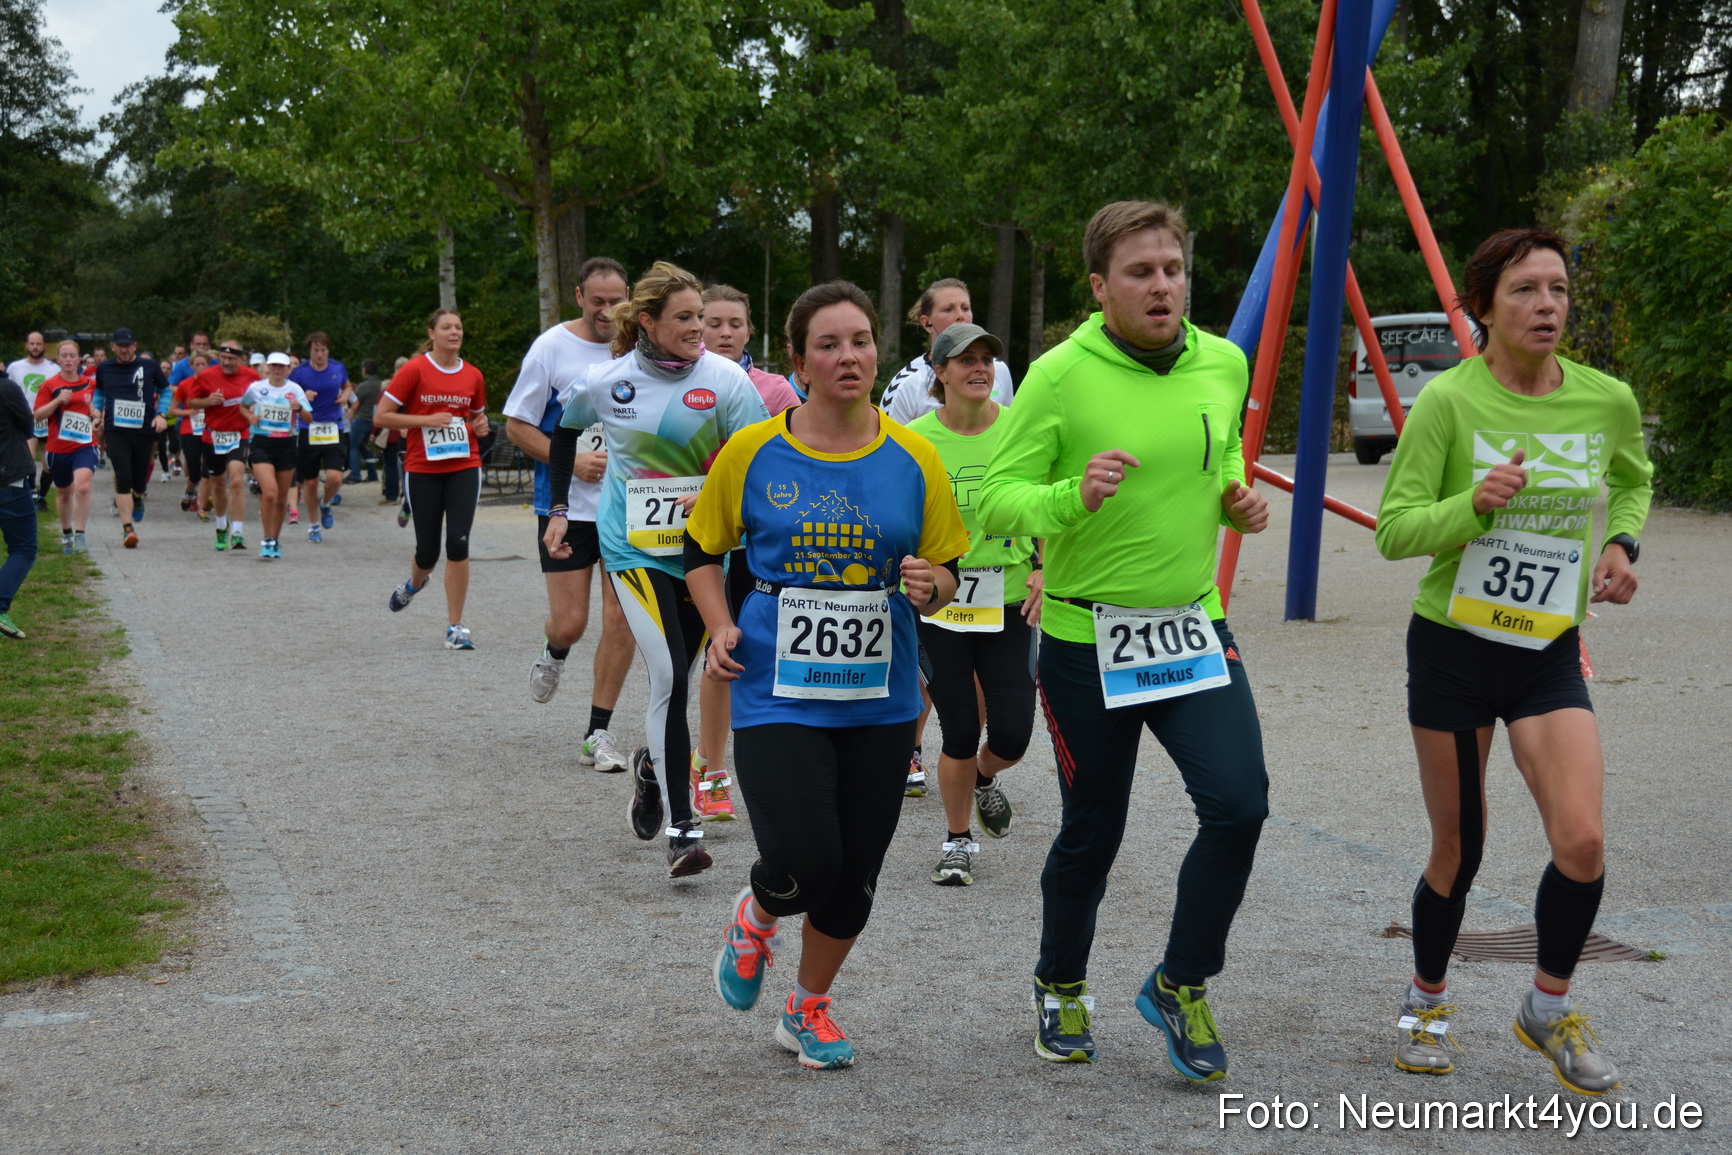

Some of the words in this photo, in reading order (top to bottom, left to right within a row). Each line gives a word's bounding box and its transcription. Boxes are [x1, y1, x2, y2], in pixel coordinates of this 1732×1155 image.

[117, 406, 142, 419] 2060
[264, 408, 290, 422] 2182
[613, 407, 637, 415] PARTL
[64, 418, 91, 434] 2426
[315, 426, 332, 435] 241
[428, 426, 465, 445] 2160
[1589, 432, 1605, 488] 2015
[628, 486, 656, 495] PARTL
[658, 485, 698, 494] Neumarkt
[657, 533, 684, 545] Ilona
[795, 551, 851, 559] 21.September
[853, 552, 873, 561] 2014
[1470, 537, 1511, 551] PARTL
[1513, 542, 1566, 561] Neumarkt
[1483, 555, 1560, 606] 357
[952, 576, 980, 604] 7
[781, 598, 822, 610] PARTL
[824, 601, 879, 613] Neumarkt
[946, 610, 974, 622] Petra
[1491, 609, 1534, 632] Karin
[790, 615, 885, 658] 2632
[1109, 616, 1208, 664] 2106
[803, 667, 866, 684] Jennifer
[1135, 667, 1194, 688] Markus
